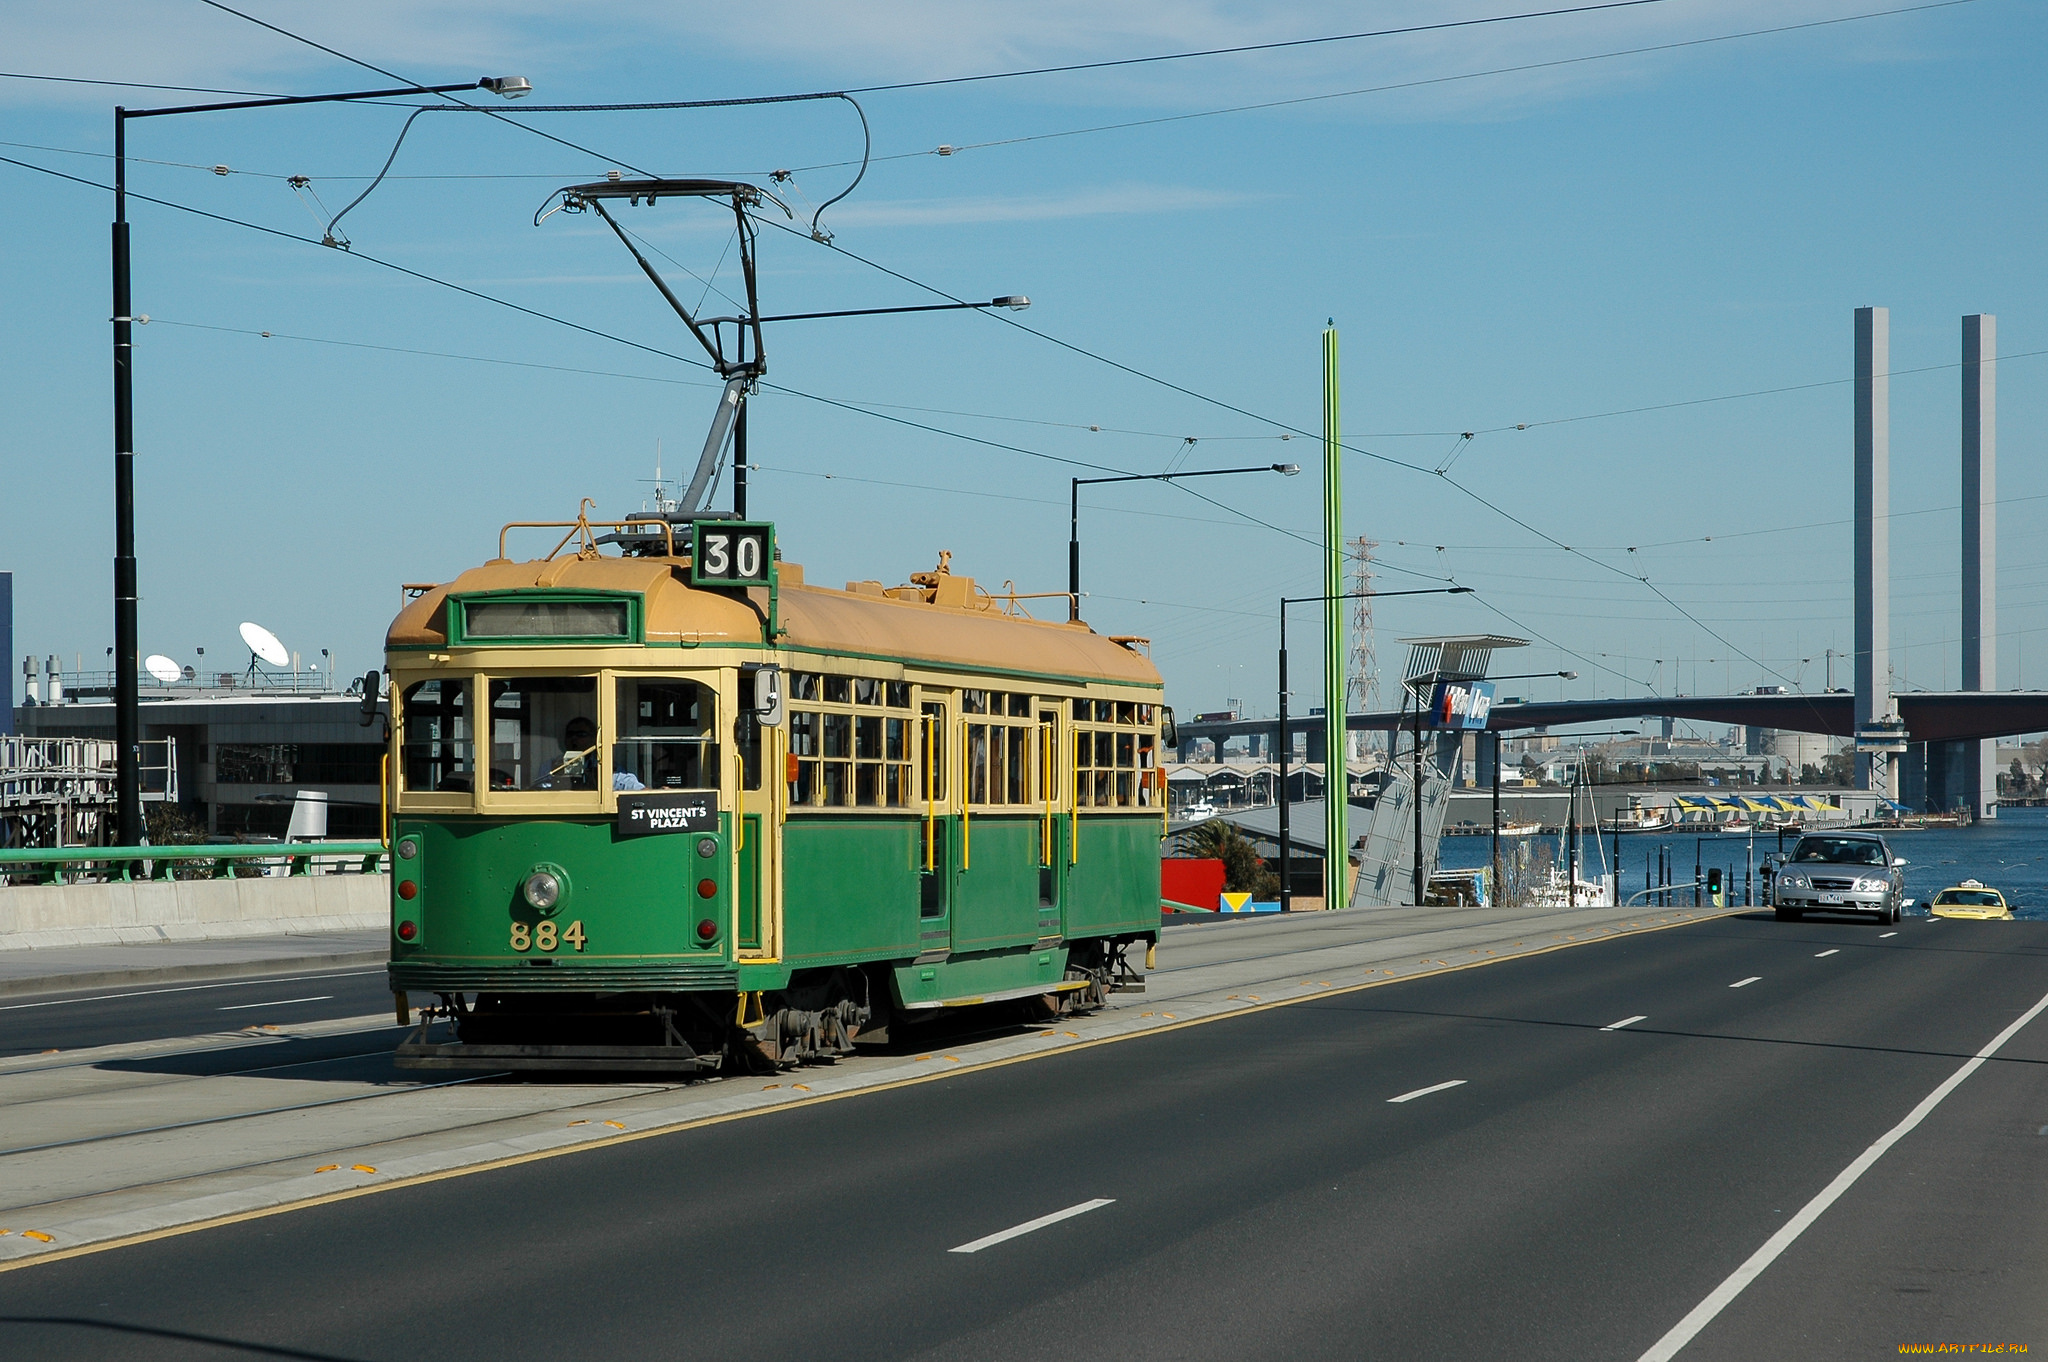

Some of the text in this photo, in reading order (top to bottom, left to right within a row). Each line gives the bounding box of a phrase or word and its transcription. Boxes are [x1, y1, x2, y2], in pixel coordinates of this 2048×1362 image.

[705, 535, 760, 577] 30
[631, 807, 707, 820] ST VINCENT'S
[650, 818, 688, 829] PLAZA
[510, 920, 587, 952] 884
